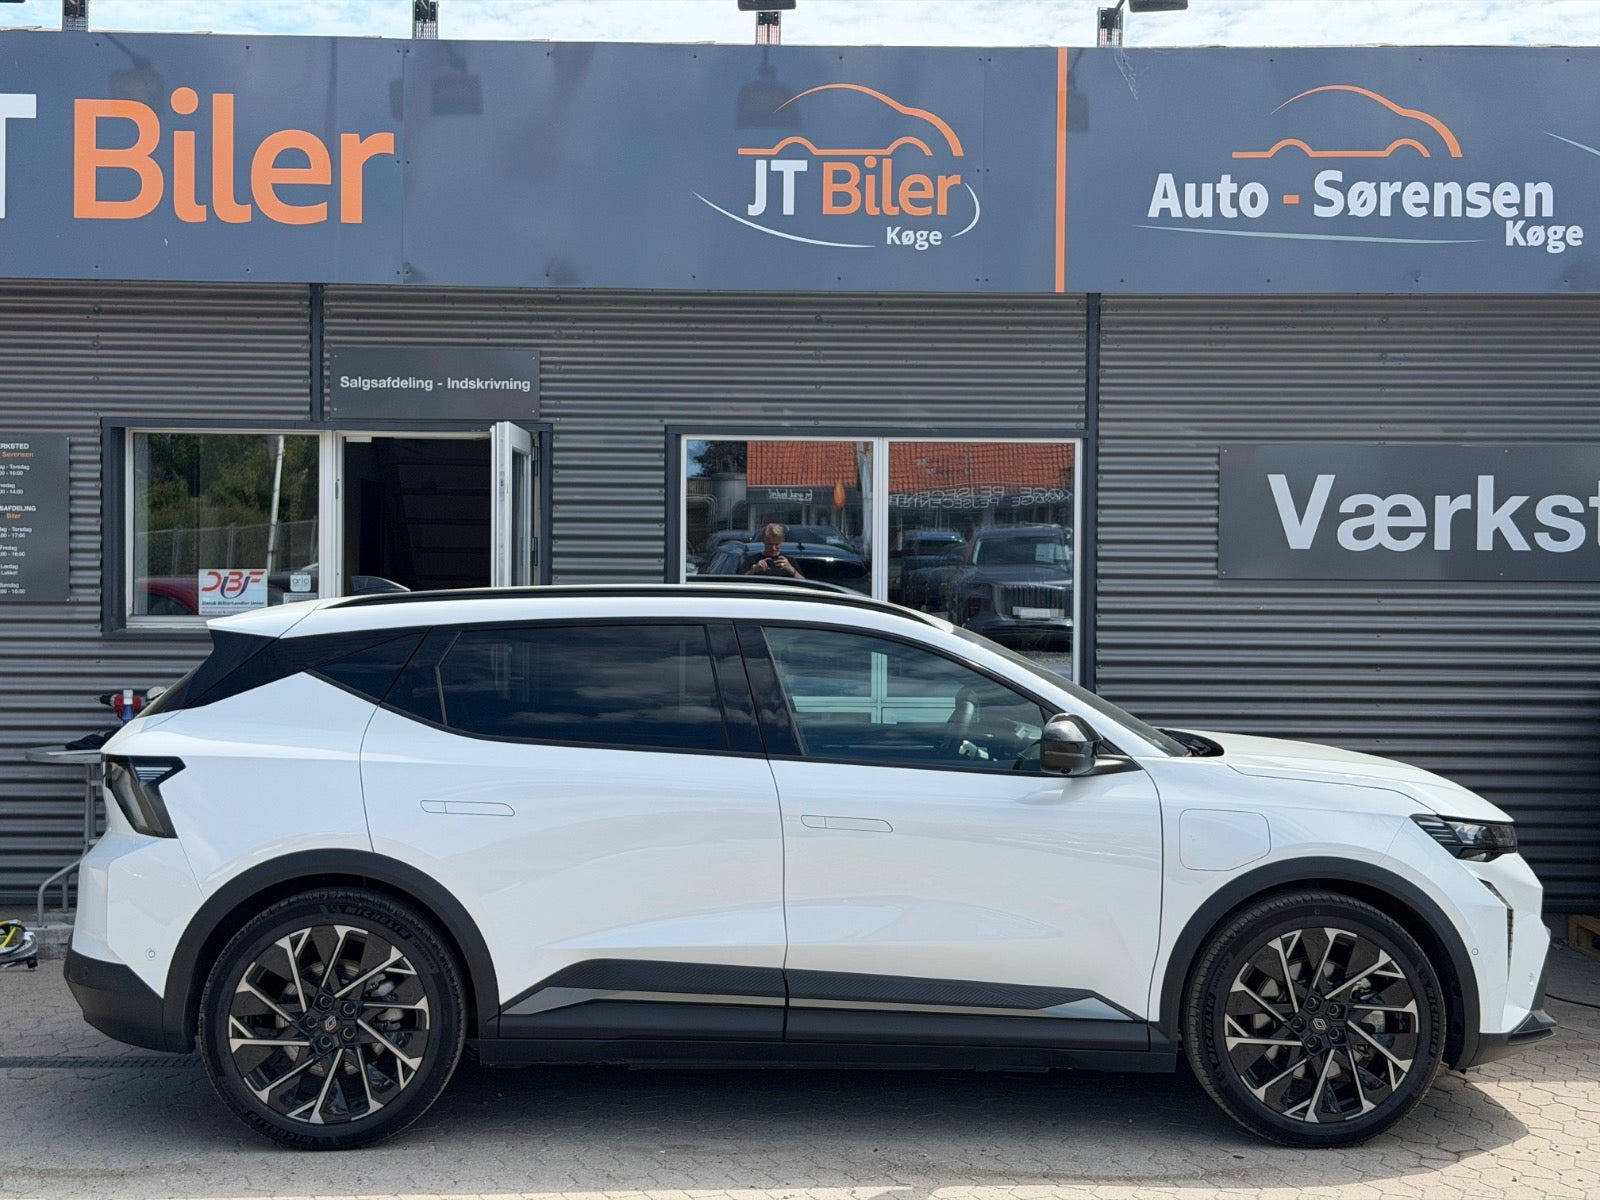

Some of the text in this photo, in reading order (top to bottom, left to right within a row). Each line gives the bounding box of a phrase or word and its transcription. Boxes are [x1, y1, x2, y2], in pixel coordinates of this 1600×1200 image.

[74, 87, 394, 225] Biler
[748, 156, 961, 216] JT Biler
[1148, 173, 1269, 219] Auto
[1313, 169, 1553, 218] Sørensen
[886, 226, 942, 250] Køge
[1505, 220, 1584, 253] Køge
[340, 376, 433, 392] Salgsafdeling
[447, 377, 531, 393] Indskrivning
